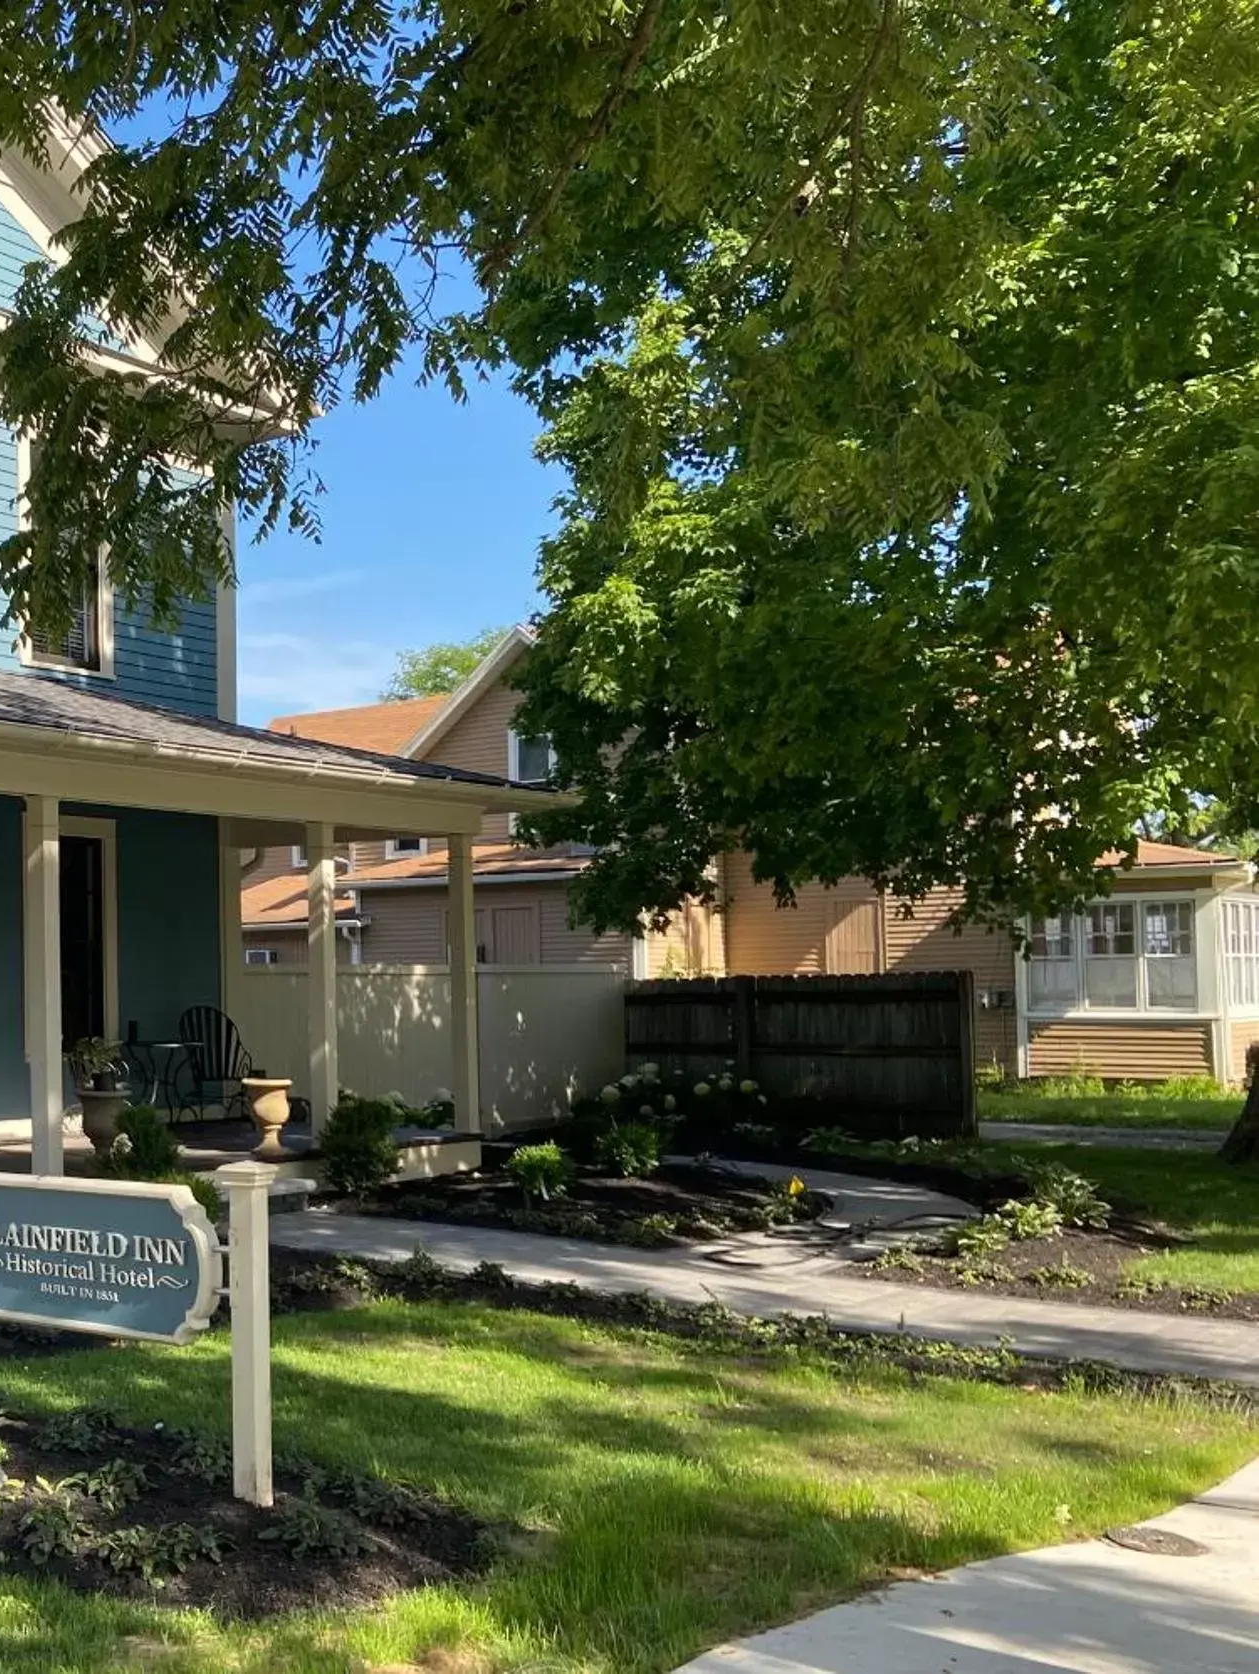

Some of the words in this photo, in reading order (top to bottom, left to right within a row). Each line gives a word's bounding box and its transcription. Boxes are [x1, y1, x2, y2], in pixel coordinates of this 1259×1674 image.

[134, 1235, 186, 1266] INN
[6, 1251, 94, 1282] Historical
[100, 1263, 155, 1289] Hotel
[40, 1282, 77, 1296] BUILT
[80, 1287, 93, 1299] IN
